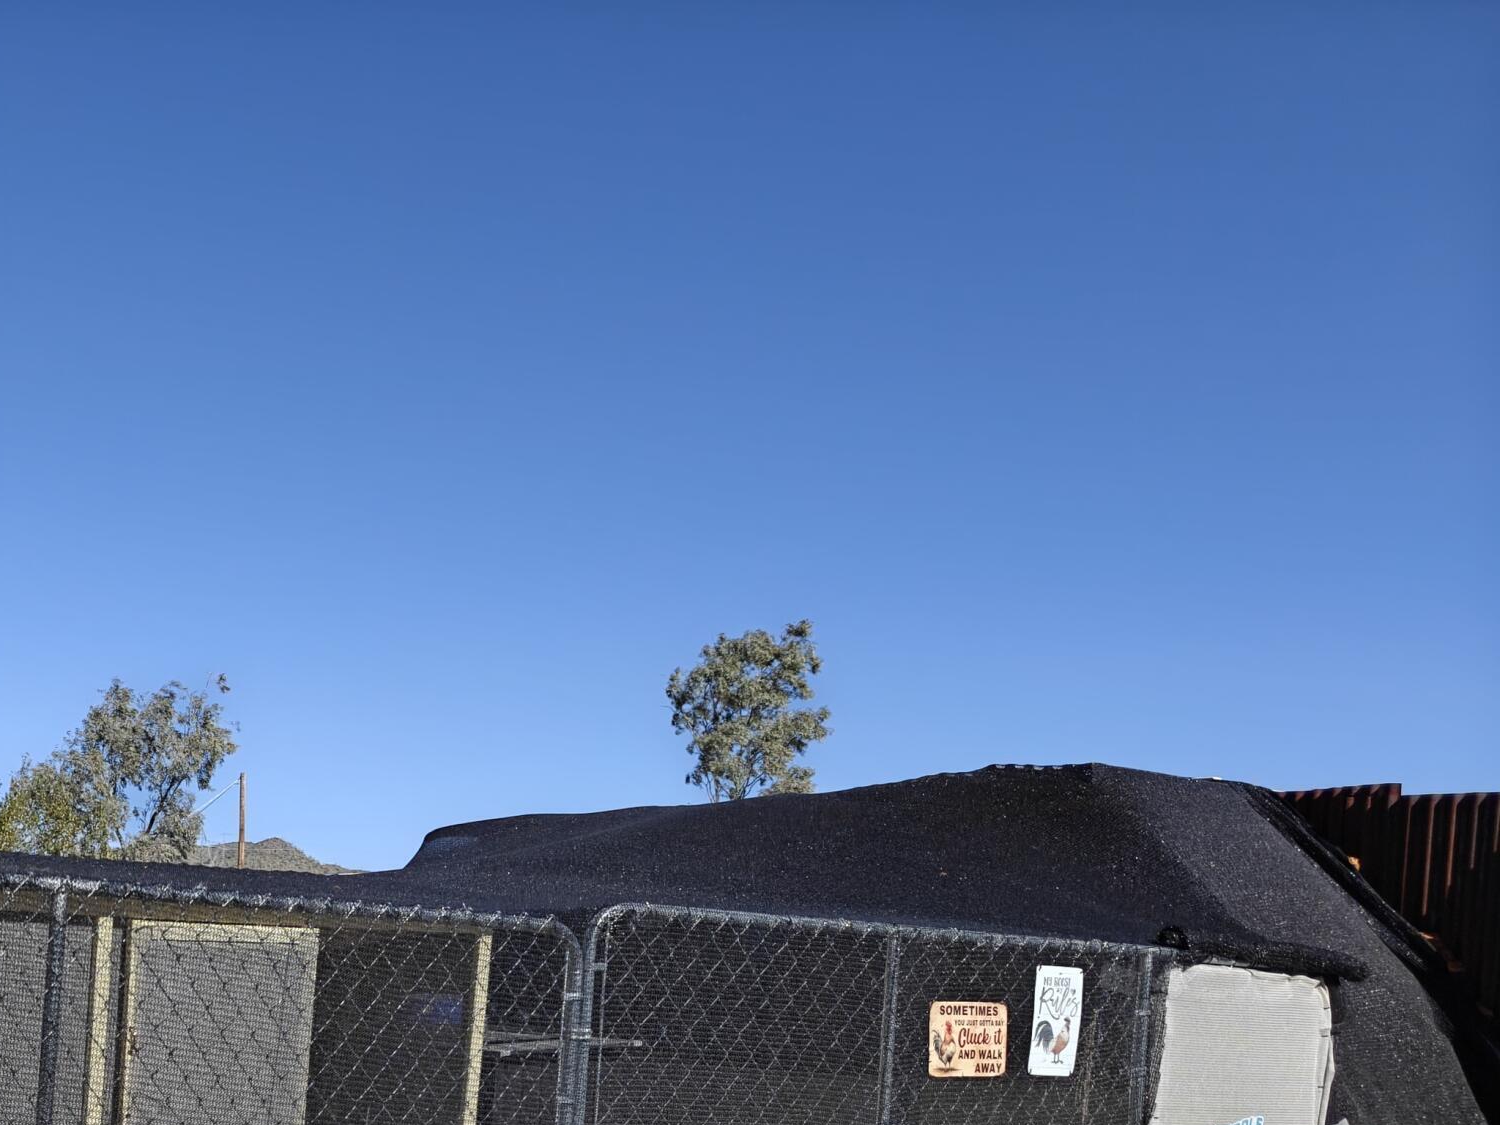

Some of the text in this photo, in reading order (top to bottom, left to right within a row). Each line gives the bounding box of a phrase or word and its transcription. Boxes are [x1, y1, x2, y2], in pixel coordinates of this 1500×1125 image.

[1039, 986, 1080, 1020] Rules
[939, 1005, 999, 1016] SOMETIMES
[954, 1019, 1004, 1027] YOU JUST GOTTA SAY
[958, 1027, 1003, 1048] Cluck it
[958, 1049, 1003, 1060] AND WALK
[974, 1062, 1002, 1073] AWAY
